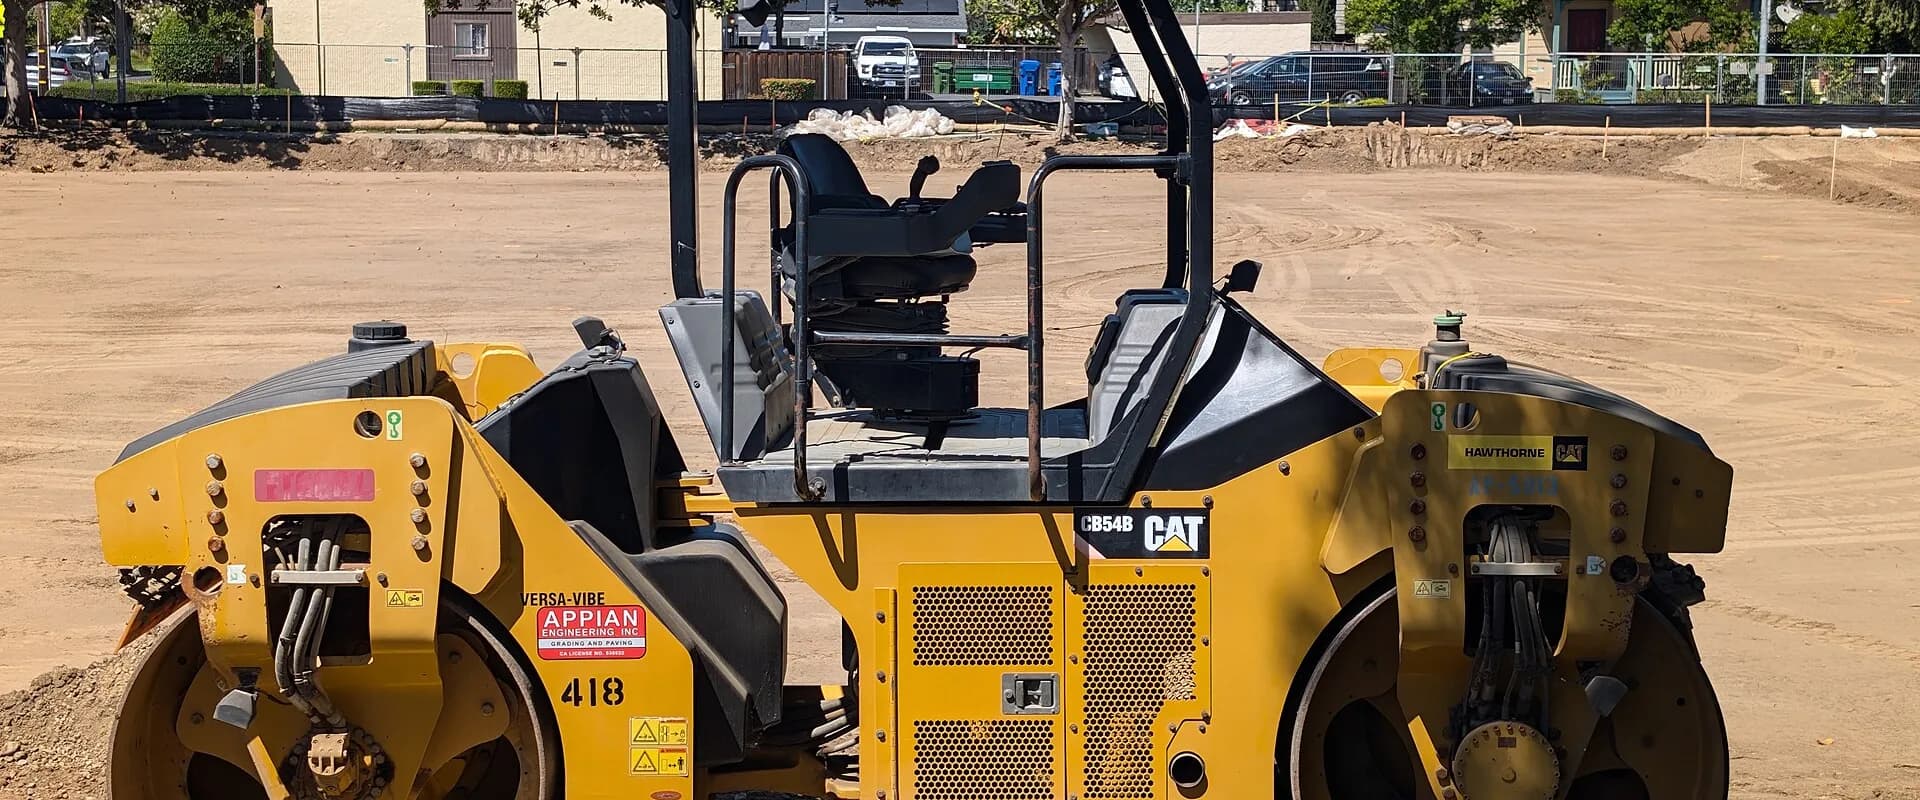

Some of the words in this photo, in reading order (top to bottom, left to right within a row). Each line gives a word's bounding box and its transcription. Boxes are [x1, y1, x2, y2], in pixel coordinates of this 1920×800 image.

[1465, 447, 1545, 458] HAWTHORNE
[1556, 444, 1584, 462] CAT
[1081, 515, 1134, 532] CB54B
[1144, 515, 1204, 552] CAT
[520, 592, 605, 606] VERSA-VIBE
[543, 609, 638, 628] APPIAN
[541, 628, 615, 637] ENGINEERING
[621, 627, 639, 636] INC
[561, 678, 624, 707] 418
